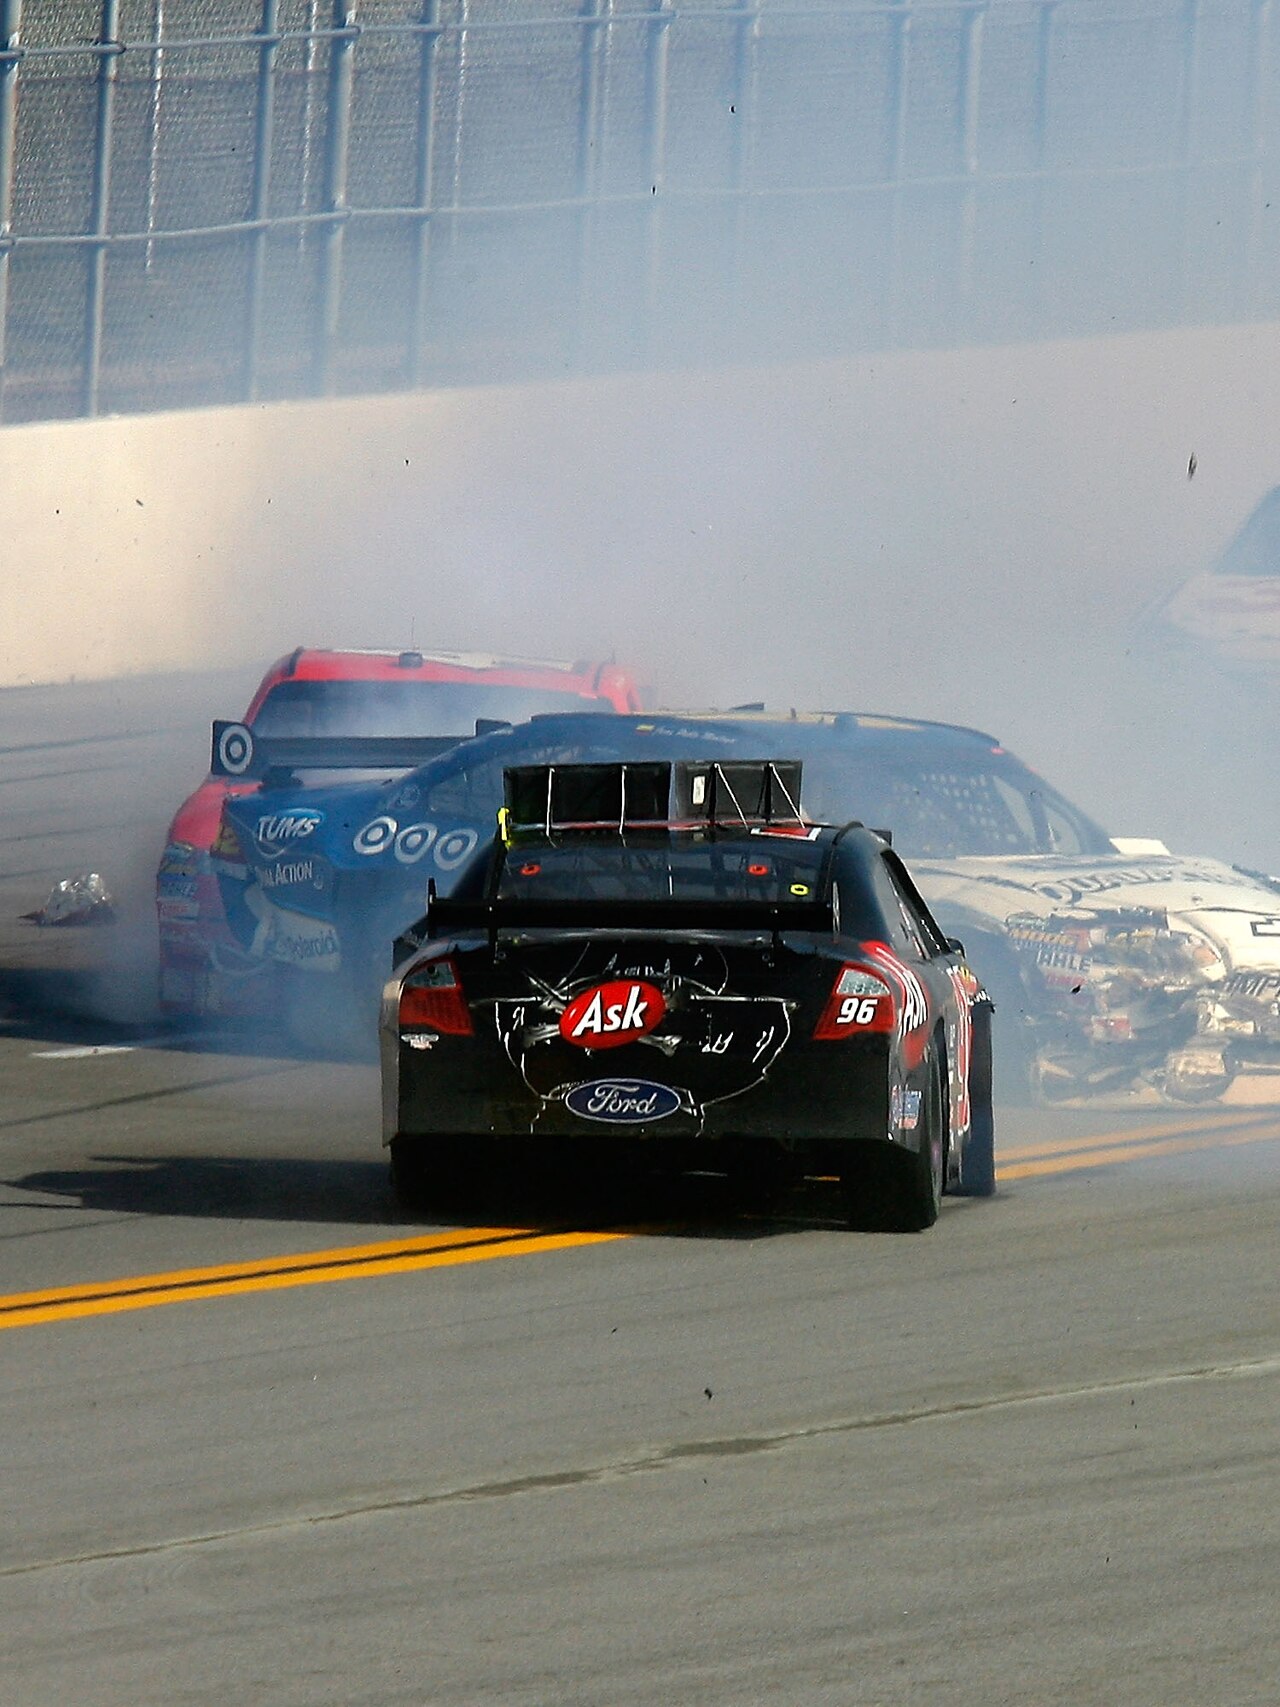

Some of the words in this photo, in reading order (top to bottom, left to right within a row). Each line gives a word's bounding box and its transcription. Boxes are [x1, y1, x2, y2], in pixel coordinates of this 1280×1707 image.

[257, 814, 322, 843] TUMS
[571, 985, 648, 1037] Ask
[836, 997, 878, 1025] 96
[586, 1083, 658, 1114] Ford
